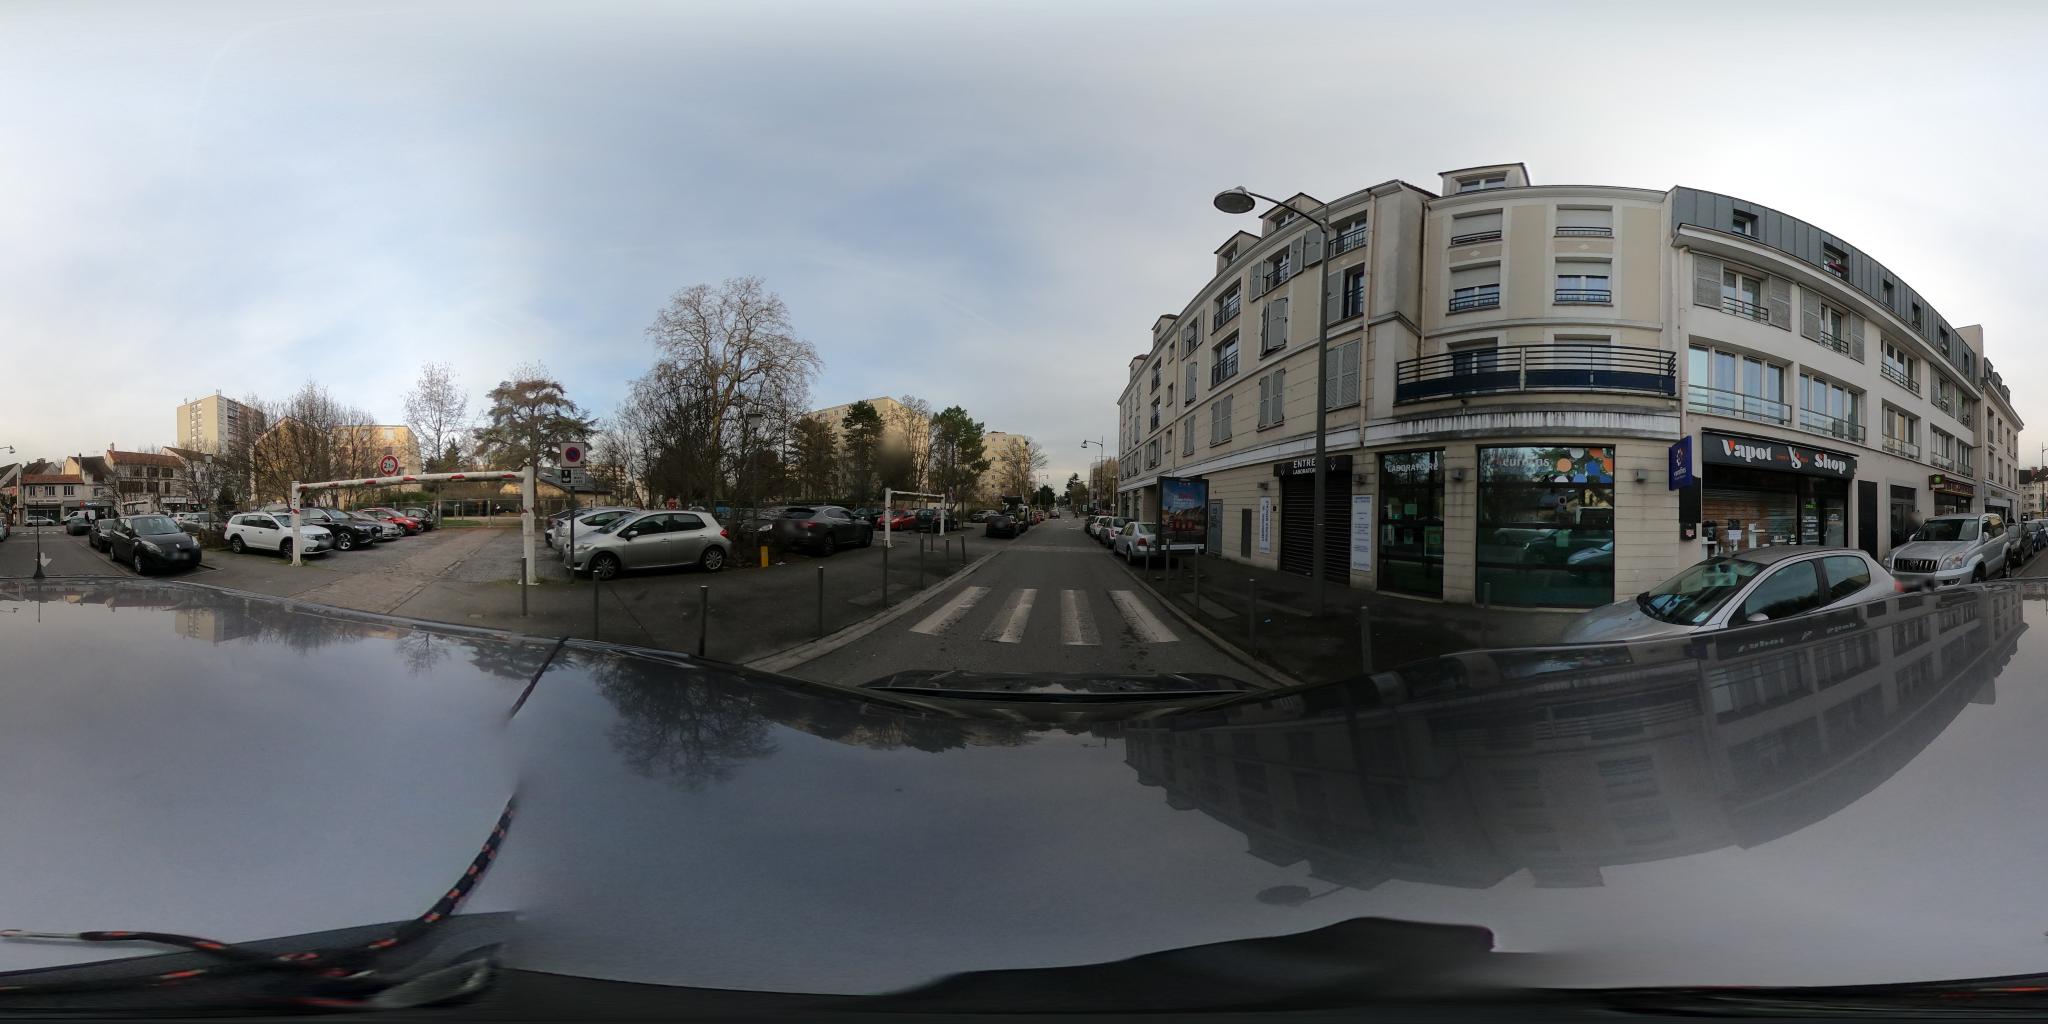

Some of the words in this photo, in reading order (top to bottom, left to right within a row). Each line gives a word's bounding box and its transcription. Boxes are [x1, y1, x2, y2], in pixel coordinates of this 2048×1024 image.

[1293, 458, 1316, 469] ENTRE
[1721, 438, 1772, 463] Vapot
[1814, 451, 1847, 475] Shop
